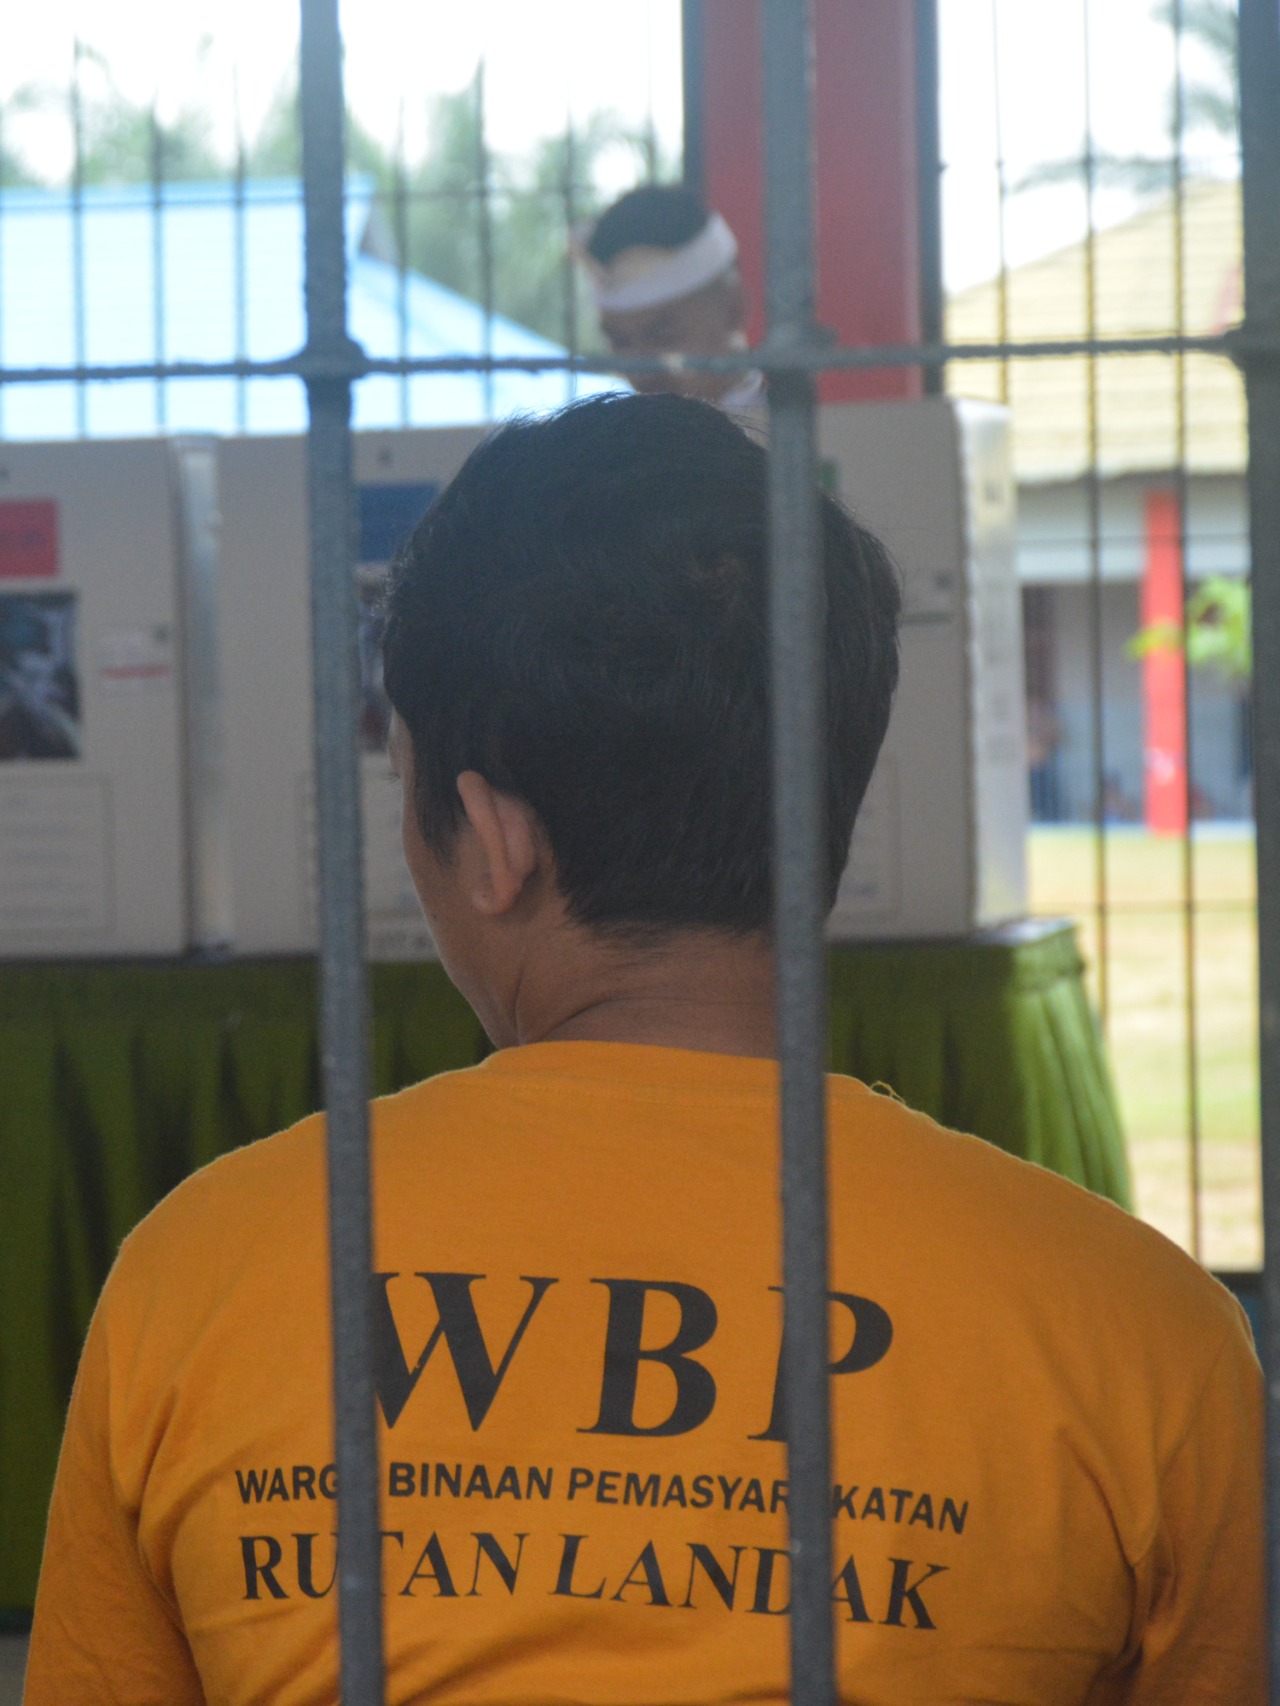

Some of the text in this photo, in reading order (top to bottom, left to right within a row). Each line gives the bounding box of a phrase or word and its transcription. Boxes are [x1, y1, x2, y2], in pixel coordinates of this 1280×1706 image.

[235, 1462, 968, 1534] WARG BINAAN PEMASYARKATAN
